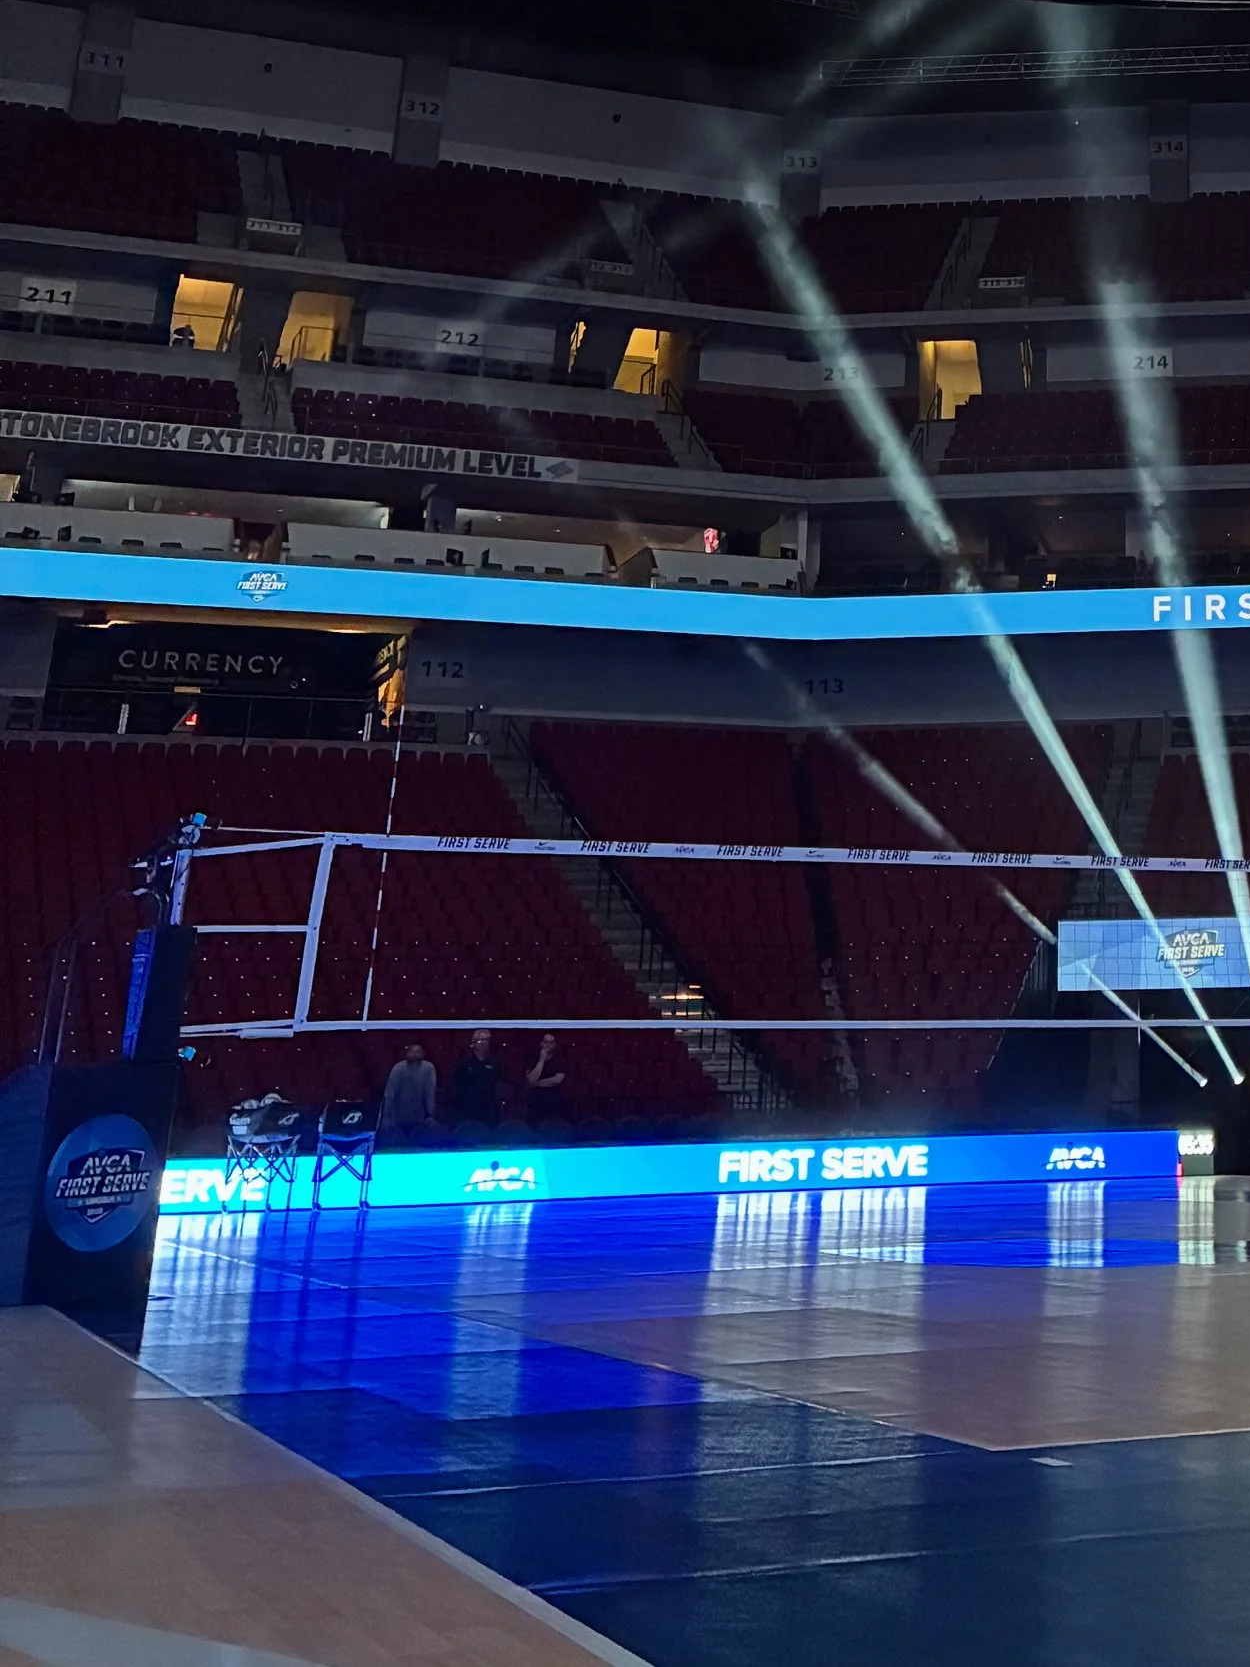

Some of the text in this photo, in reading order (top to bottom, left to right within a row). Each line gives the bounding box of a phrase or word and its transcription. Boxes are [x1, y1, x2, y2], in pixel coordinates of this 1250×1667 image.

[86, 50, 124, 69] 311
[405, 99, 440, 116] 312
[1152, 141, 1184, 153] 314
[786, 156, 818, 168] 313
[26, 286, 72, 305] 211
[441, 329, 480, 347] 212
[1134, 355, 1168, 370] 214
[824, 367, 859, 382] 213
[0, 411, 542, 478] TONEBROOK EXTERIOR PREMIUM LEVEL
[249, 572, 277, 582] AVCA
[237, 581, 288, 590] FIRST SERVE
[118, 649, 284, 675] CURRENCY
[422, 660, 464, 679] 112
[805, 678, 845, 695] 113
[437, 837, 511, 850] FIRST SERVE
[581, 841, 651, 854] FIRST SERVE
[717, 845, 783, 858] FIRST SERVE
[847, 848, 911, 861] FIRST SERVE
[971, 853, 1033, 865] FIRST SERVE
[1091, 857, 1150, 868] FIRST SERVE
[1205, 860, 1231, 869] FIRST
[1173, 932, 1209, 947] AVCA
[1157, 943, 1225, 961] FIRST SERVE
[80, 1154, 131, 1175] AVCA
[718, 1145, 929, 1183] FIRST SERVE
[1046, 1146, 1106, 1170] AVCA
[56, 1172, 151, 1197] FIRST SERVE
[464, 1166, 536, 1192] AVCA
